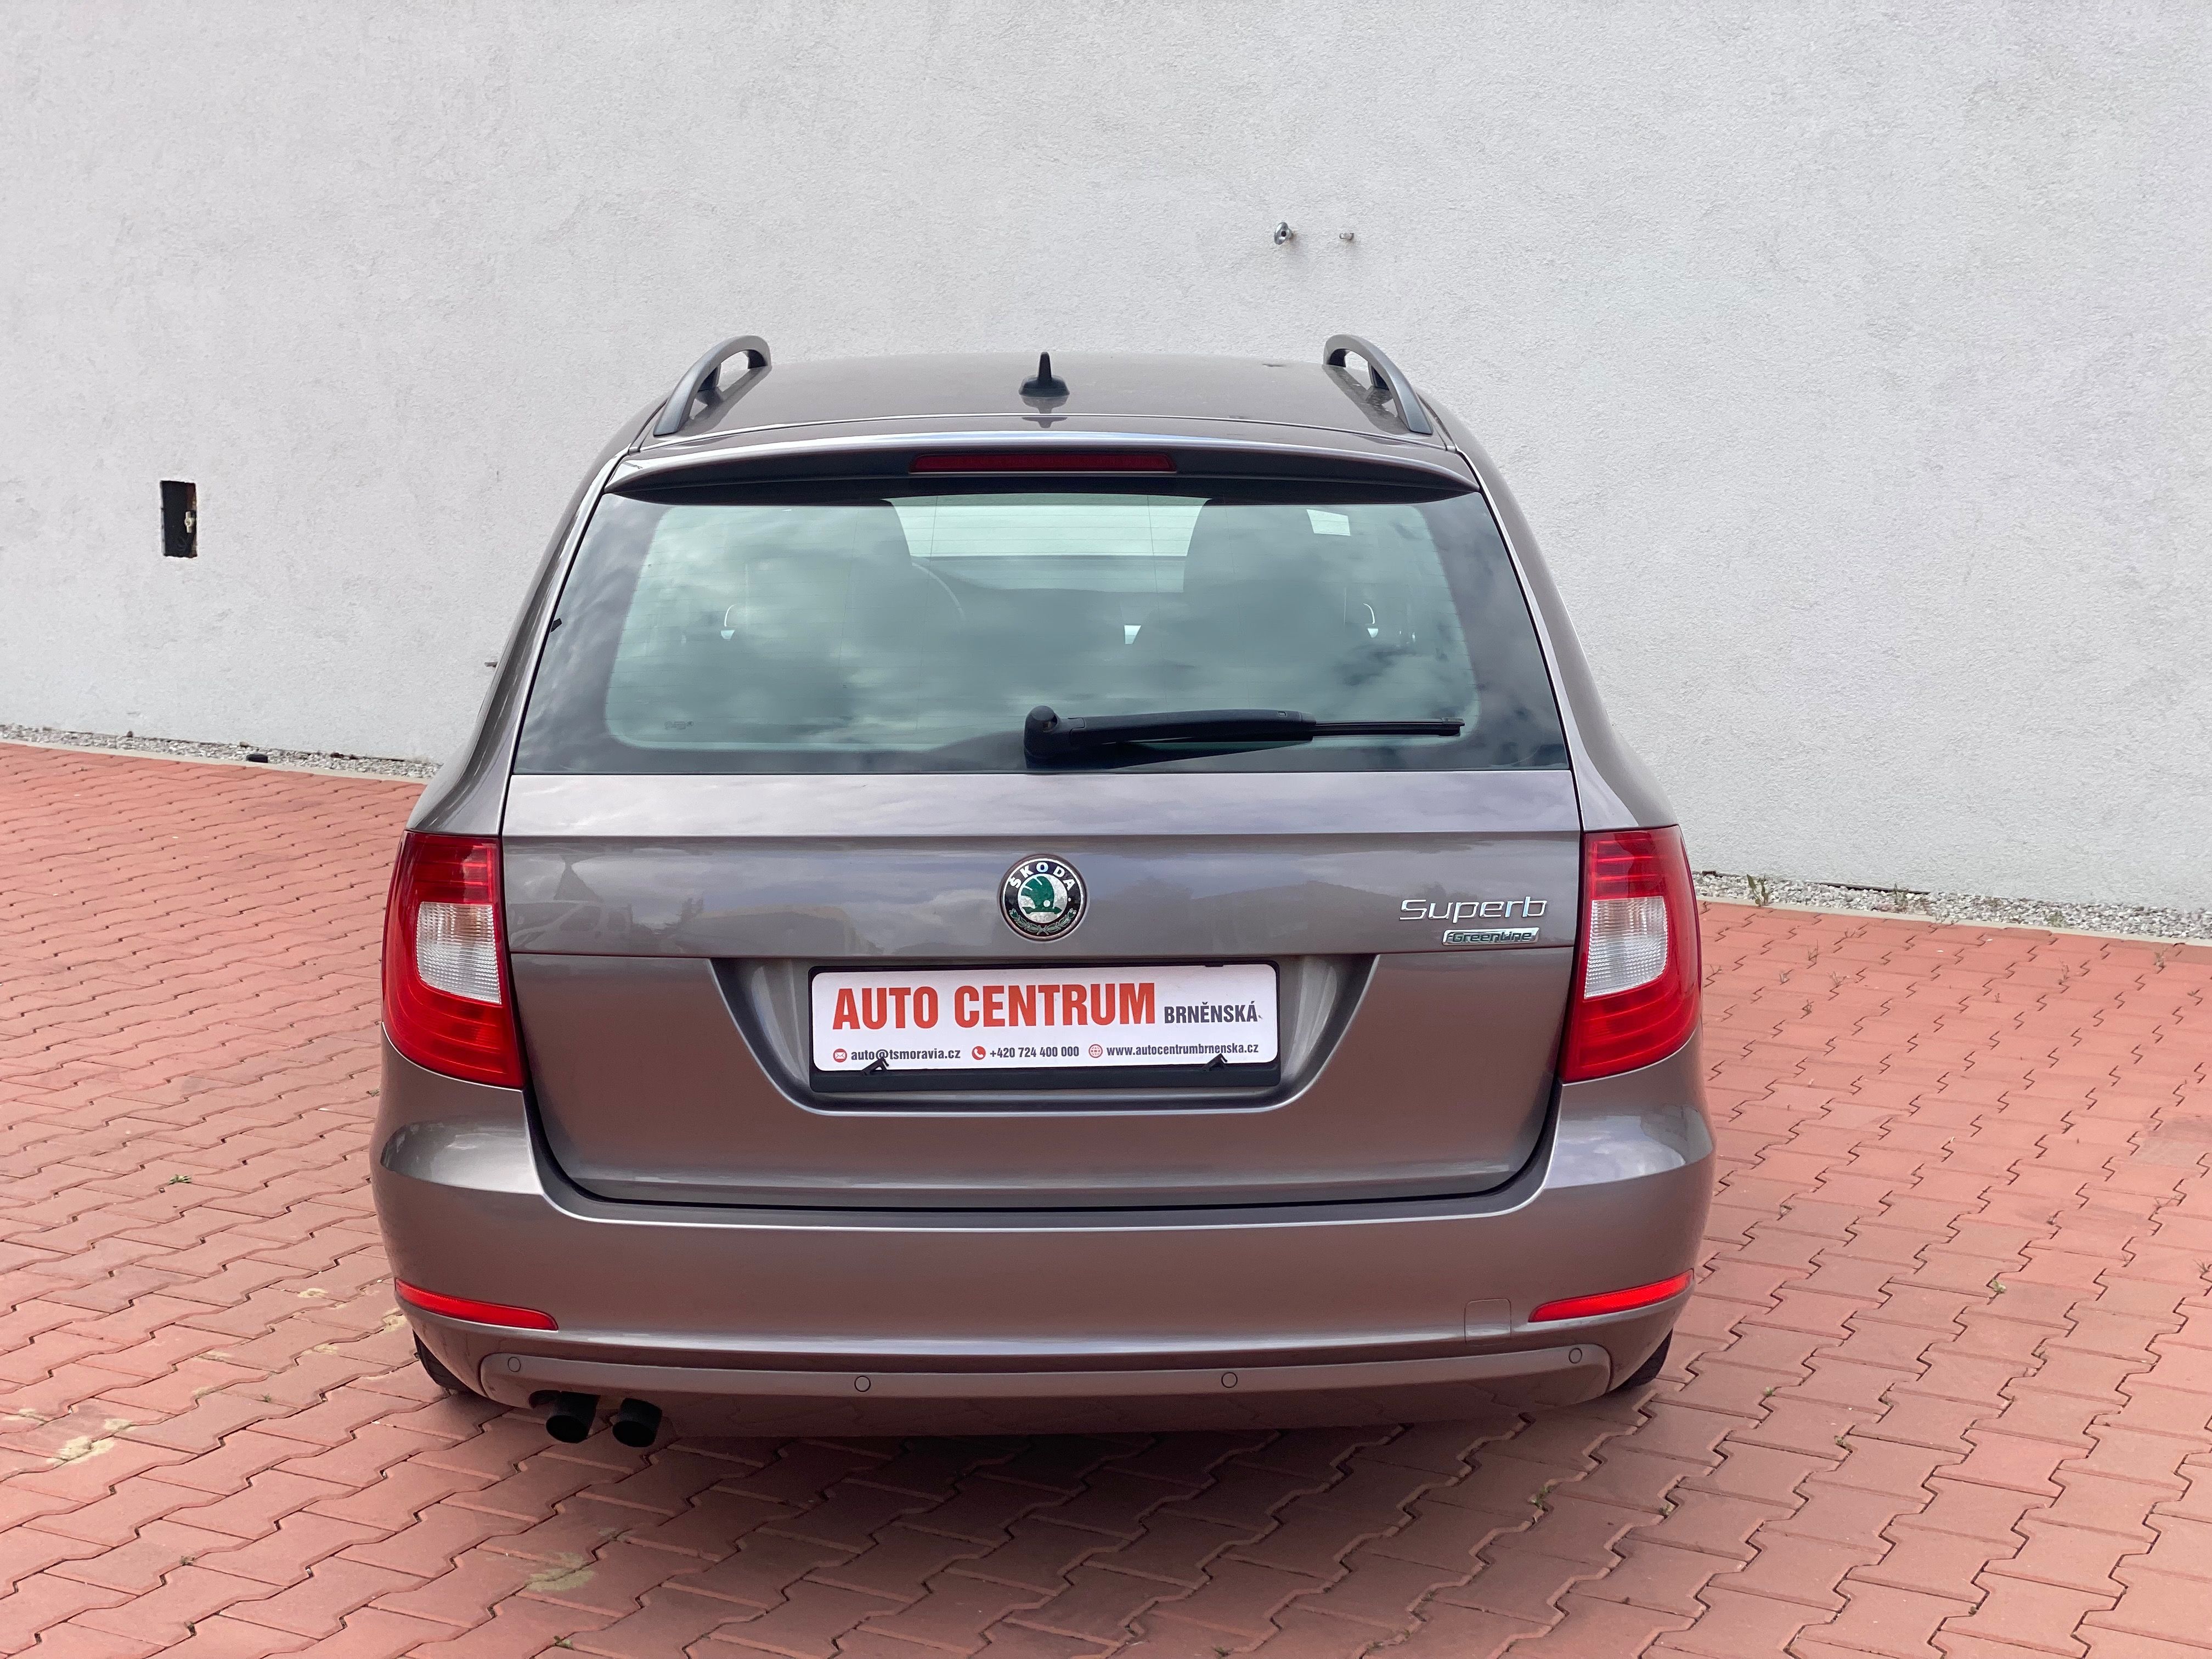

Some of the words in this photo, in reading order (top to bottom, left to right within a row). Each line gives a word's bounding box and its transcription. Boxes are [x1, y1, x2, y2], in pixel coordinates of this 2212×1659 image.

[1399, 896, 1547, 923] Superb
[832, 986, 938, 1030] AUTO
[954, 982, 1155, 1029] CENTRUM
[1164, 1001, 1258, 1024] BRNĚNSKÁ
[851, 1048, 961, 1060] auto@tsmoravia.cz
[990, 1047, 1015, 1058] +420
[1018, 1047, 1037, 1058] 724
[1040, 1046, 1058, 1057] 400
[1060, 1046, 1080, 1057] 000
[1106, 1043, 1259, 1056] www.autocentrumbrnenska.cz
